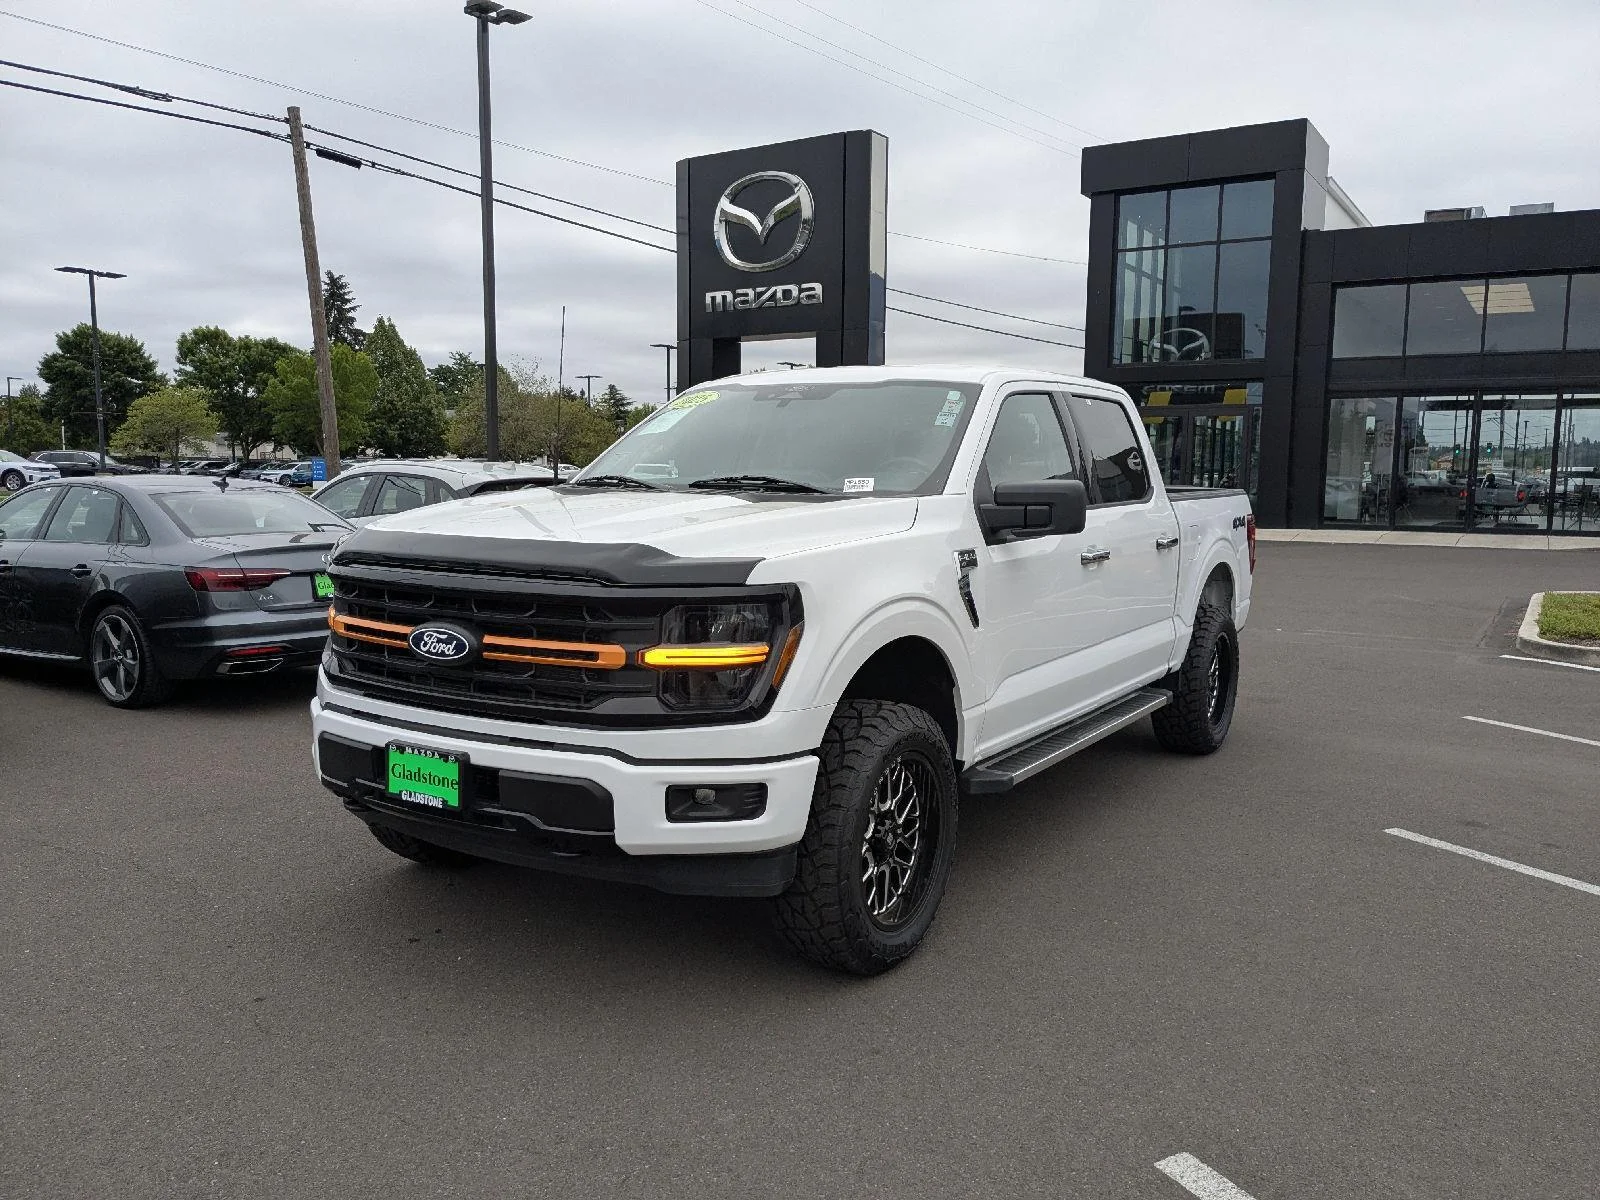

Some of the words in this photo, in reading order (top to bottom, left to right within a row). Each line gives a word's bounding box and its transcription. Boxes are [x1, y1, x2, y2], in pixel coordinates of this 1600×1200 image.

[705, 282, 823, 313] mazda
[420, 631, 457, 655] Ford
[405, 746, 440, 760] MAZDA
[391, 763, 459, 791] Gladstone
[401, 790, 443, 809] GLADSTONE
